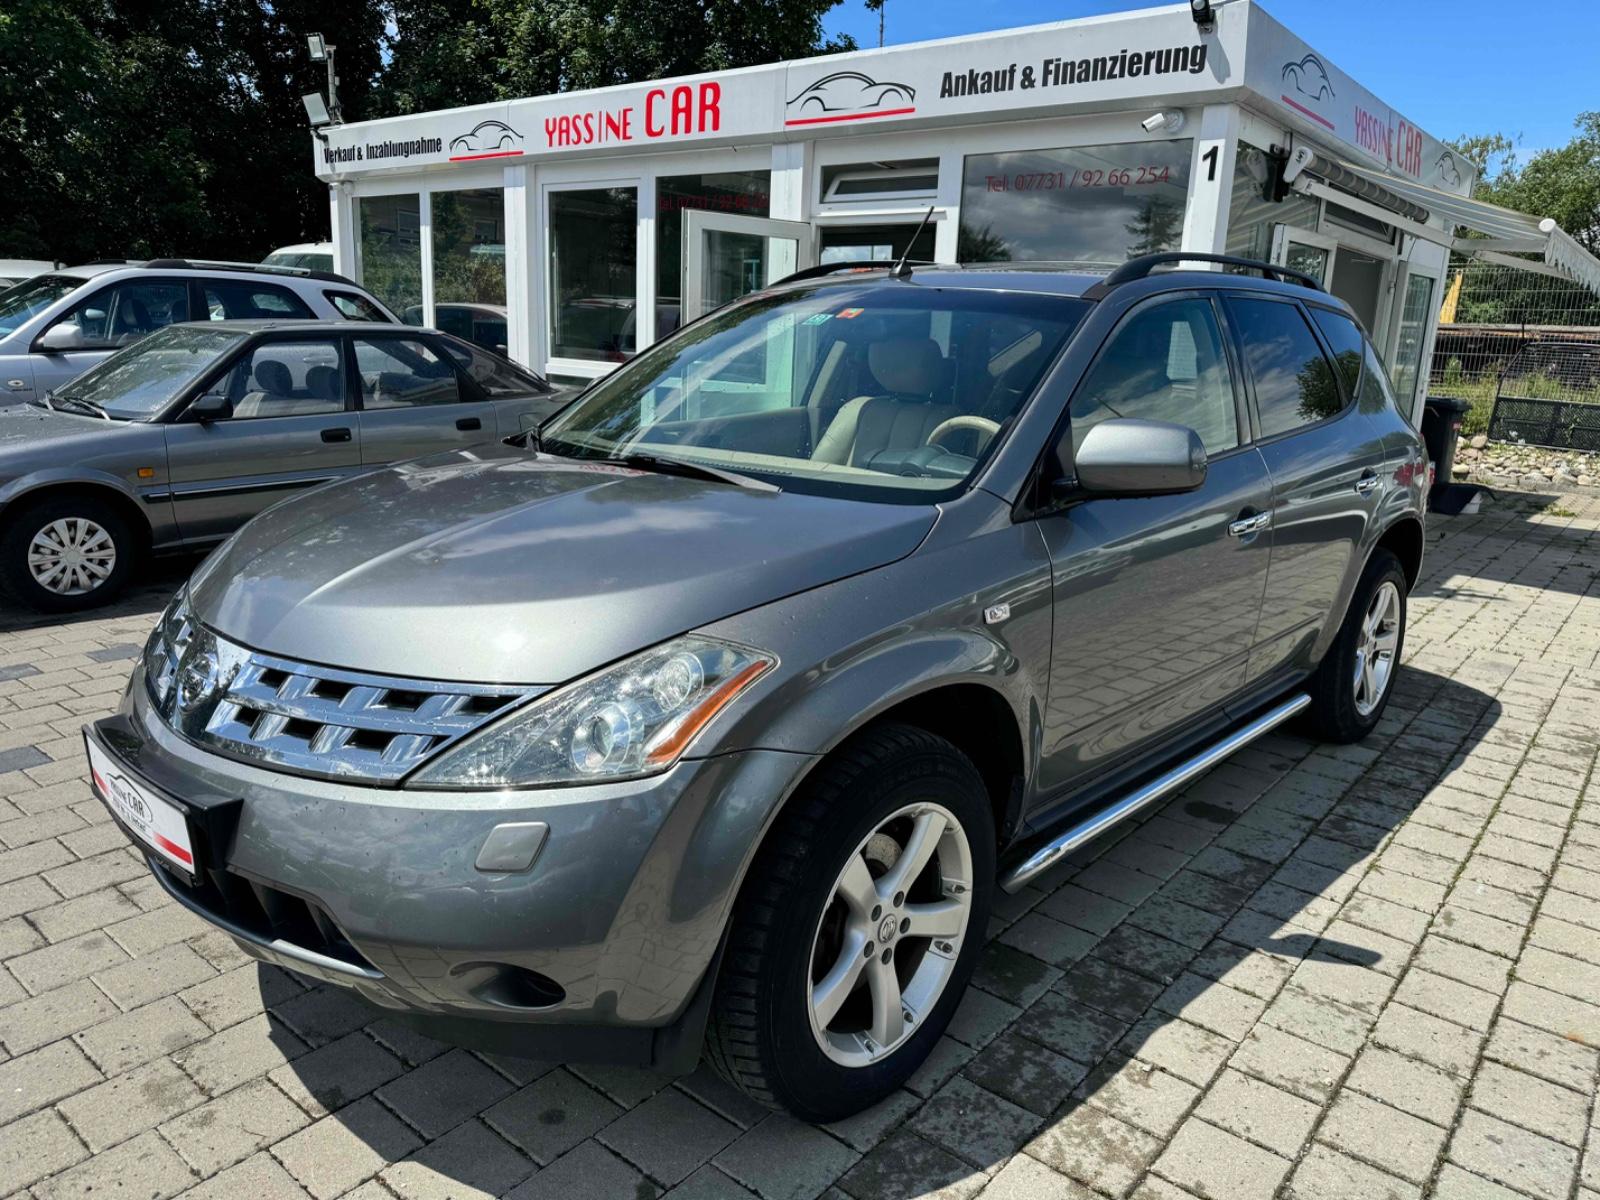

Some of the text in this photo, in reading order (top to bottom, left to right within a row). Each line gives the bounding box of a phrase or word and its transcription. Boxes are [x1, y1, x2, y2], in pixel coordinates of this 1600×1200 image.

[939, 44, 1208, 99] Ankauf & Finanzierung
[545, 81, 721, 148] YASSINE CAR
[324, 136, 442, 164] Verkauf & Inzahlungnahme
[1202, 145, 1219, 181] 1
[1355, 105, 1422, 177] YASSINE CAR
[1015, 172, 1064, 192] 07731
[1082, 169, 1104, 188] 92
[1108, 167, 1132, 186] 66
[1136, 165, 1169, 185] 254
